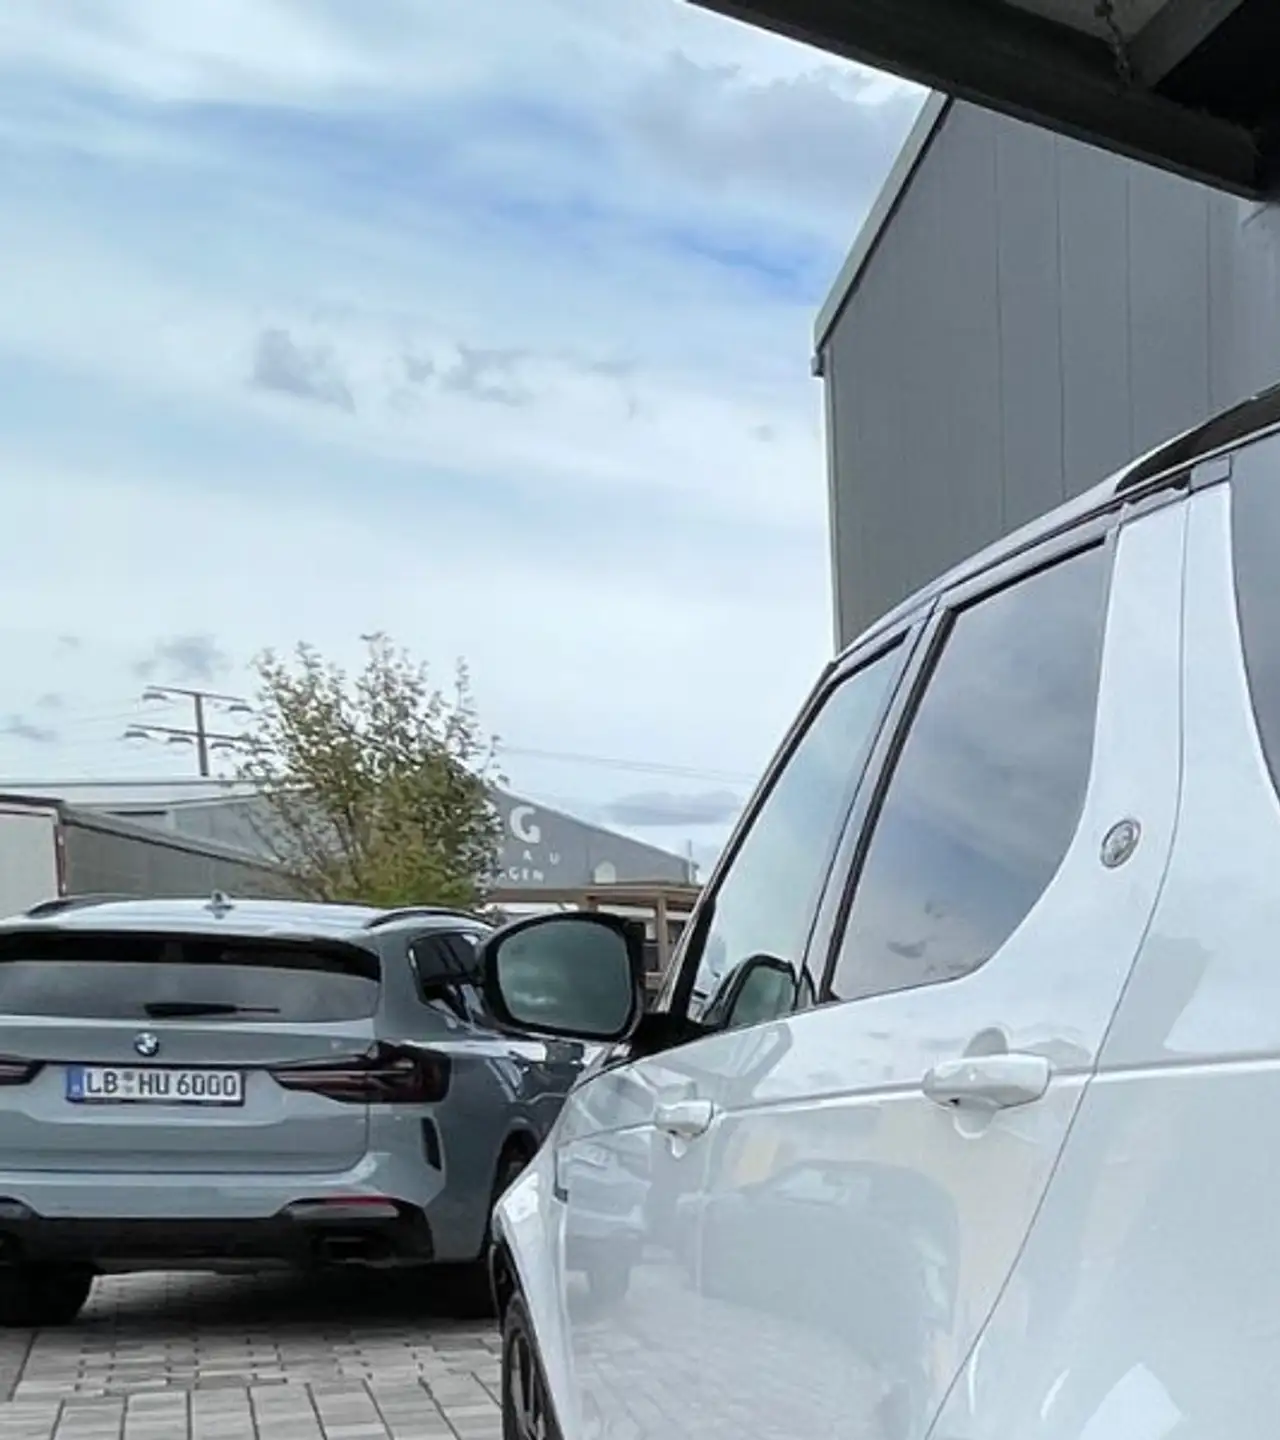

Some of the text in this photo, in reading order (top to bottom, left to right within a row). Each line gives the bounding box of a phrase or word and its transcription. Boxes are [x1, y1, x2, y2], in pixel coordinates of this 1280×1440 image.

[86, 1071, 237, 1097] LB HU 6000
